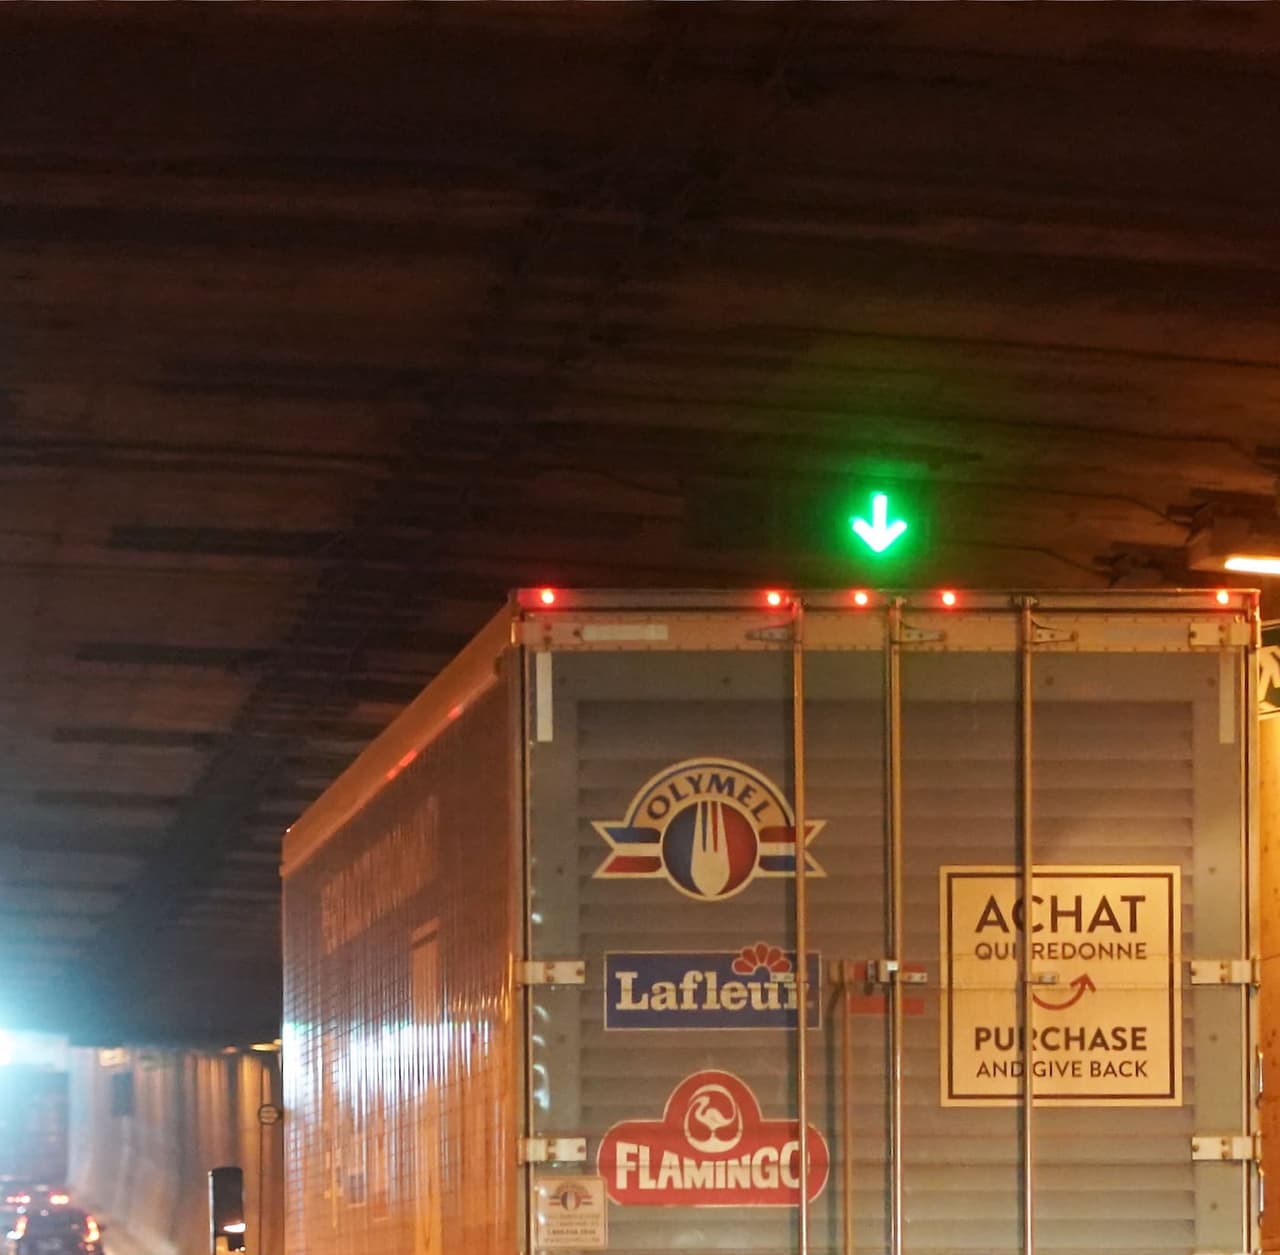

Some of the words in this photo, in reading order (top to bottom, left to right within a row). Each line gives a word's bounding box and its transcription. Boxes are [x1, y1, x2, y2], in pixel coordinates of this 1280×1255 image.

[646, 773, 771, 823] OLYMEL
[974, 895, 1147, 934] ACHAT
[1031, 941, 1148, 961] REDONNE
[974, 1026, 1148, 1052] PURCHASE
[975, 1060, 1024, 1078] AND
[1032, 1060, 1083, 1078] GIVE
[1089, 1060, 1148, 1078] BACK
[615, 1140, 811, 1190] FLAMINGO
